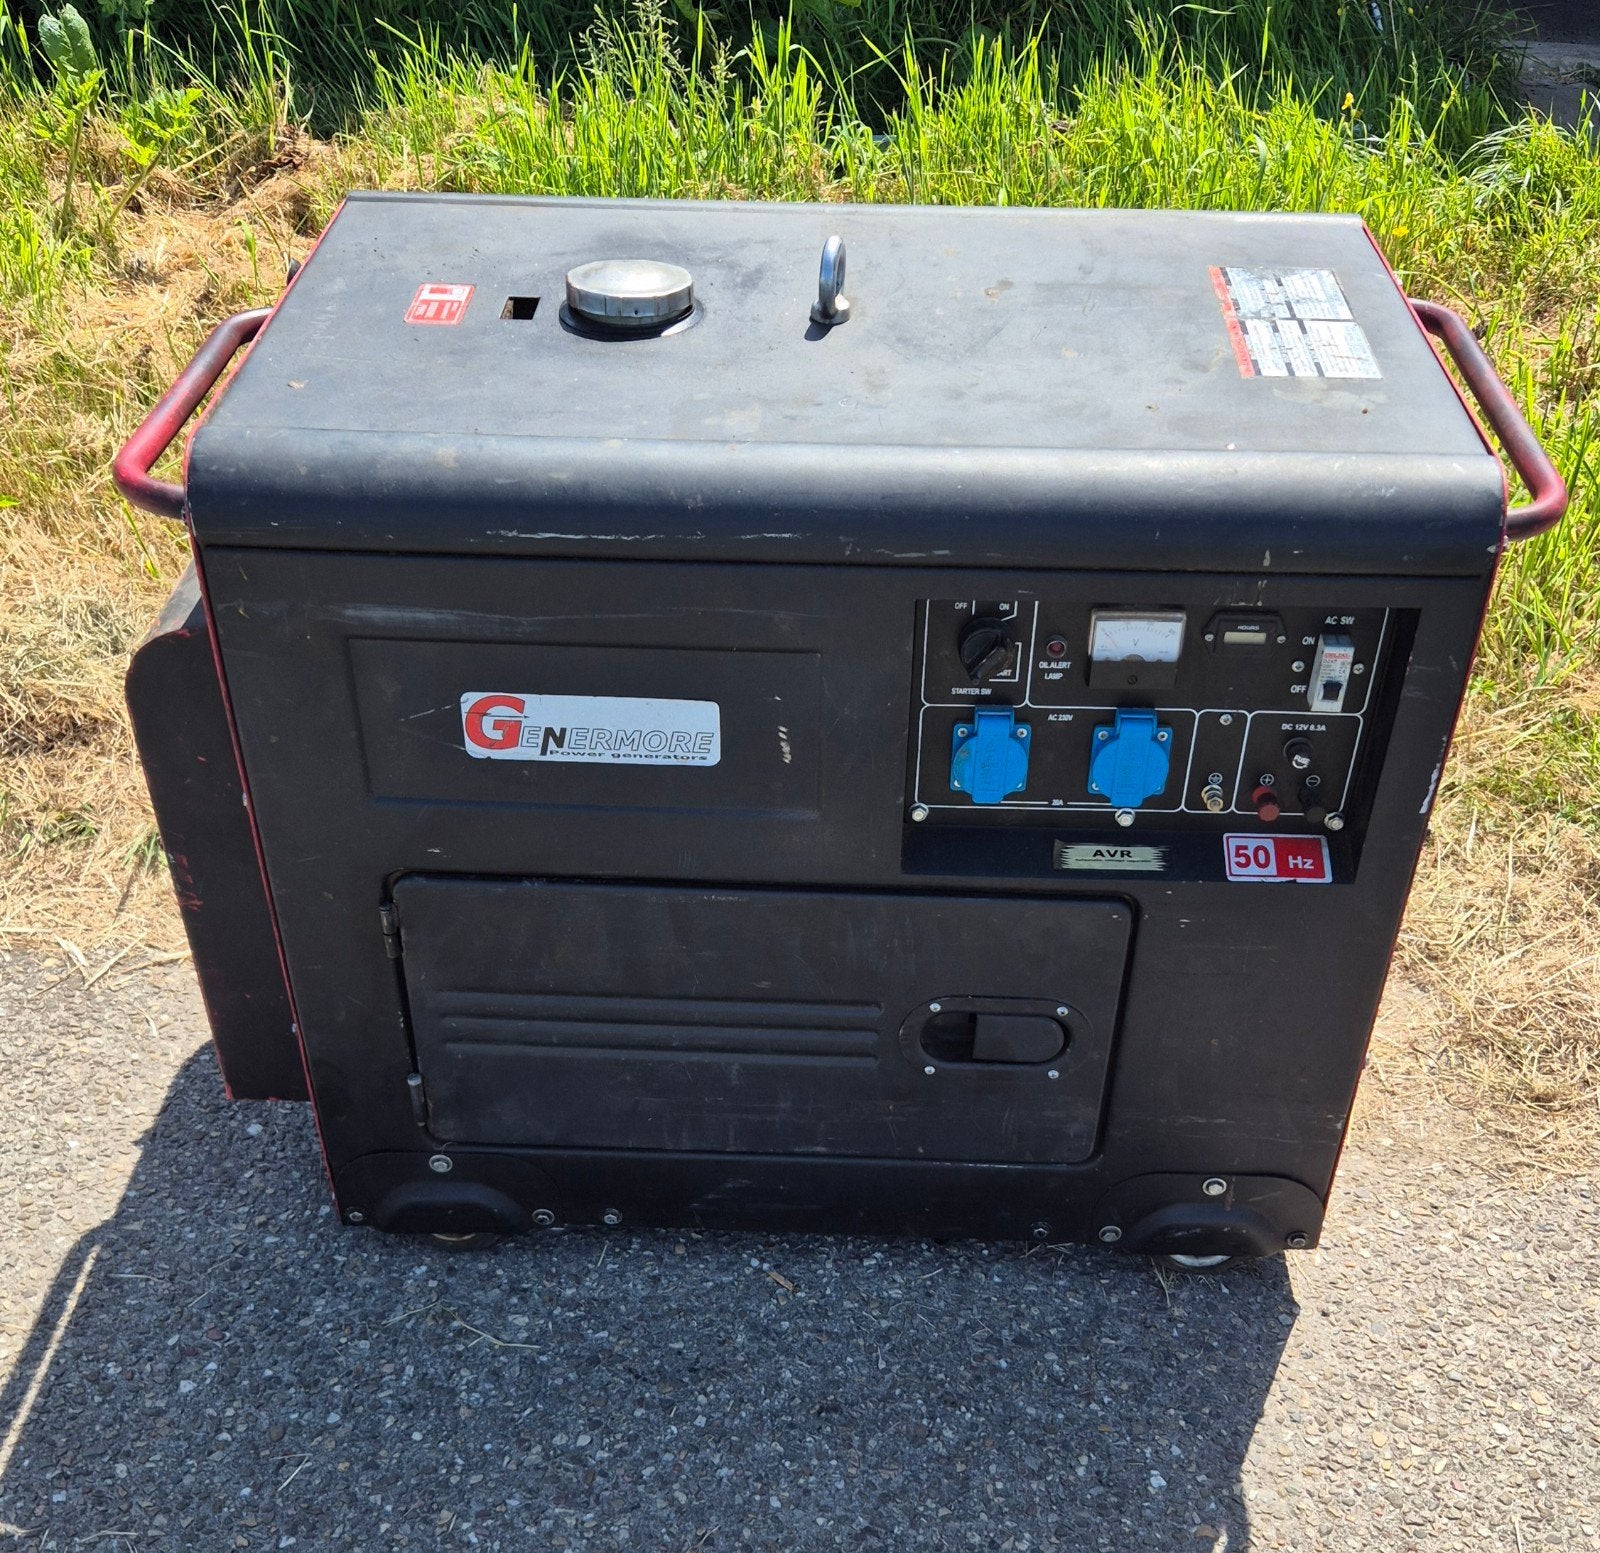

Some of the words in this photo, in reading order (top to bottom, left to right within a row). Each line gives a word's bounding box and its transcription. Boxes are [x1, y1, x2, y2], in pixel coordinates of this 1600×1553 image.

[954, 602, 968, 610] OFF
[998, 603, 1010, 611] ON
[1324, 616, 1338, 625] AC
[1340, 616, 1355, 625] SW
[1301, 636, 1316, 646] ON
[1049, 661, 1072, 669] ALERT
[951, 687, 980, 695] STARTER
[980, 687, 992, 695] SW
[1290, 684, 1307, 694] OFF
[1058, 714, 1074, 722] 230V
[465, 694, 715, 756] GENERMORE
[1281, 723, 1294, 731] DC
[1295, 723, 1309, 731] 12V
[549, 749, 605, 758] Power
[611, 752, 709, 761] generators
[1092, 849, 1132, 858] AVR
[1234, 844, 1271, 870] 50
[1287, 854, 1315, 870] Hz
